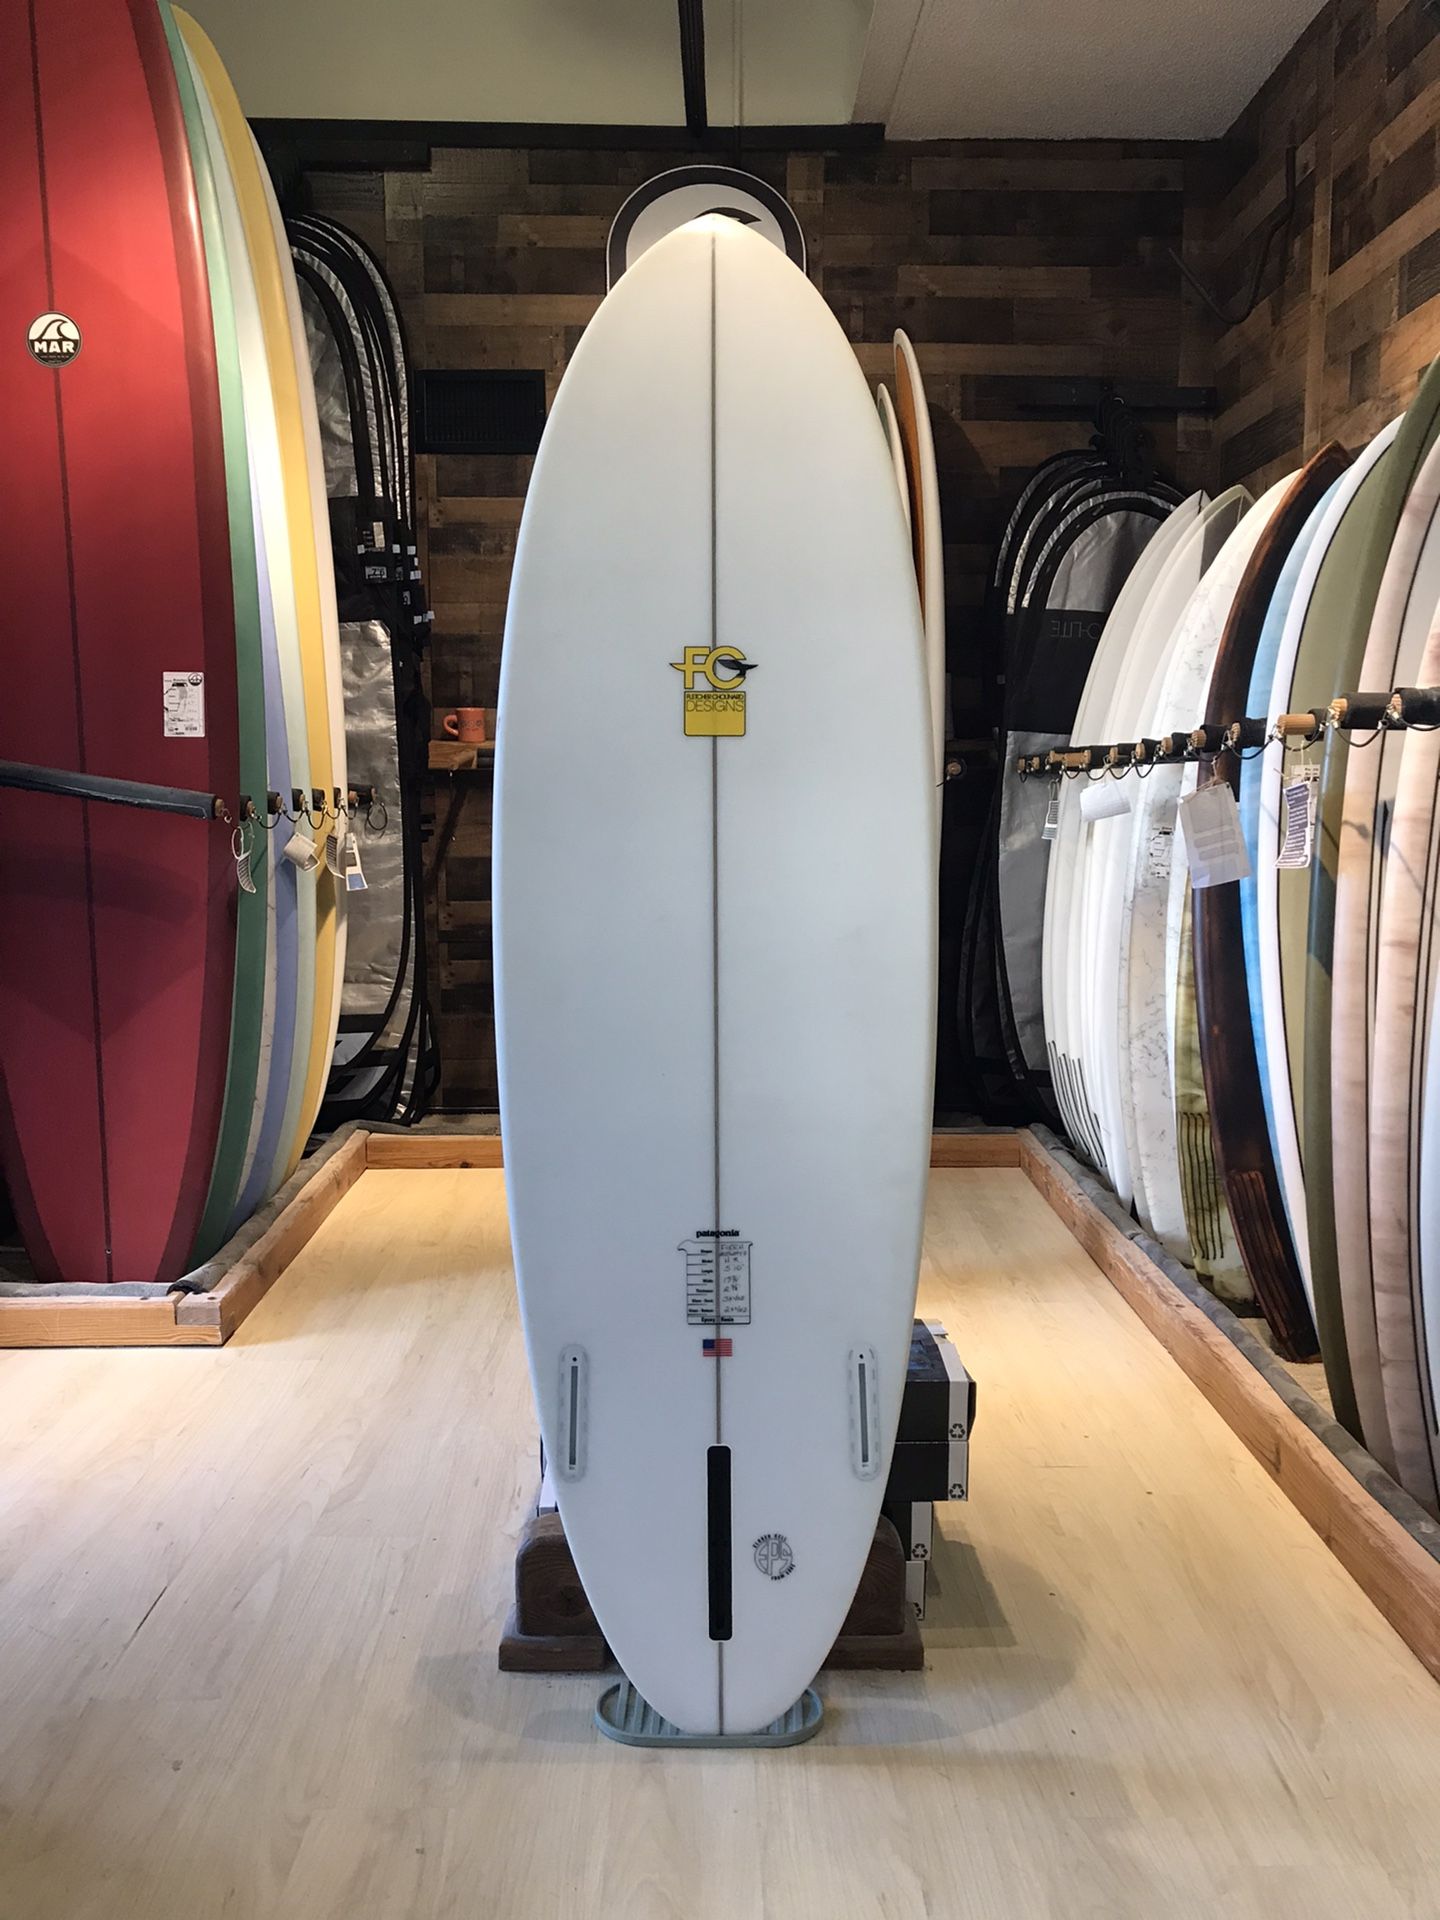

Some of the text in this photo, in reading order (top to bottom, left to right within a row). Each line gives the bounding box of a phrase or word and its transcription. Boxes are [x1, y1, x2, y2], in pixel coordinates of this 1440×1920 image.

[34, 341, 75, 353] MAR
[674, 645, 750, 690] FC
[686, 700, 744, 712] DESIGNS
[696, 1229, 740, 1239] patagonia
